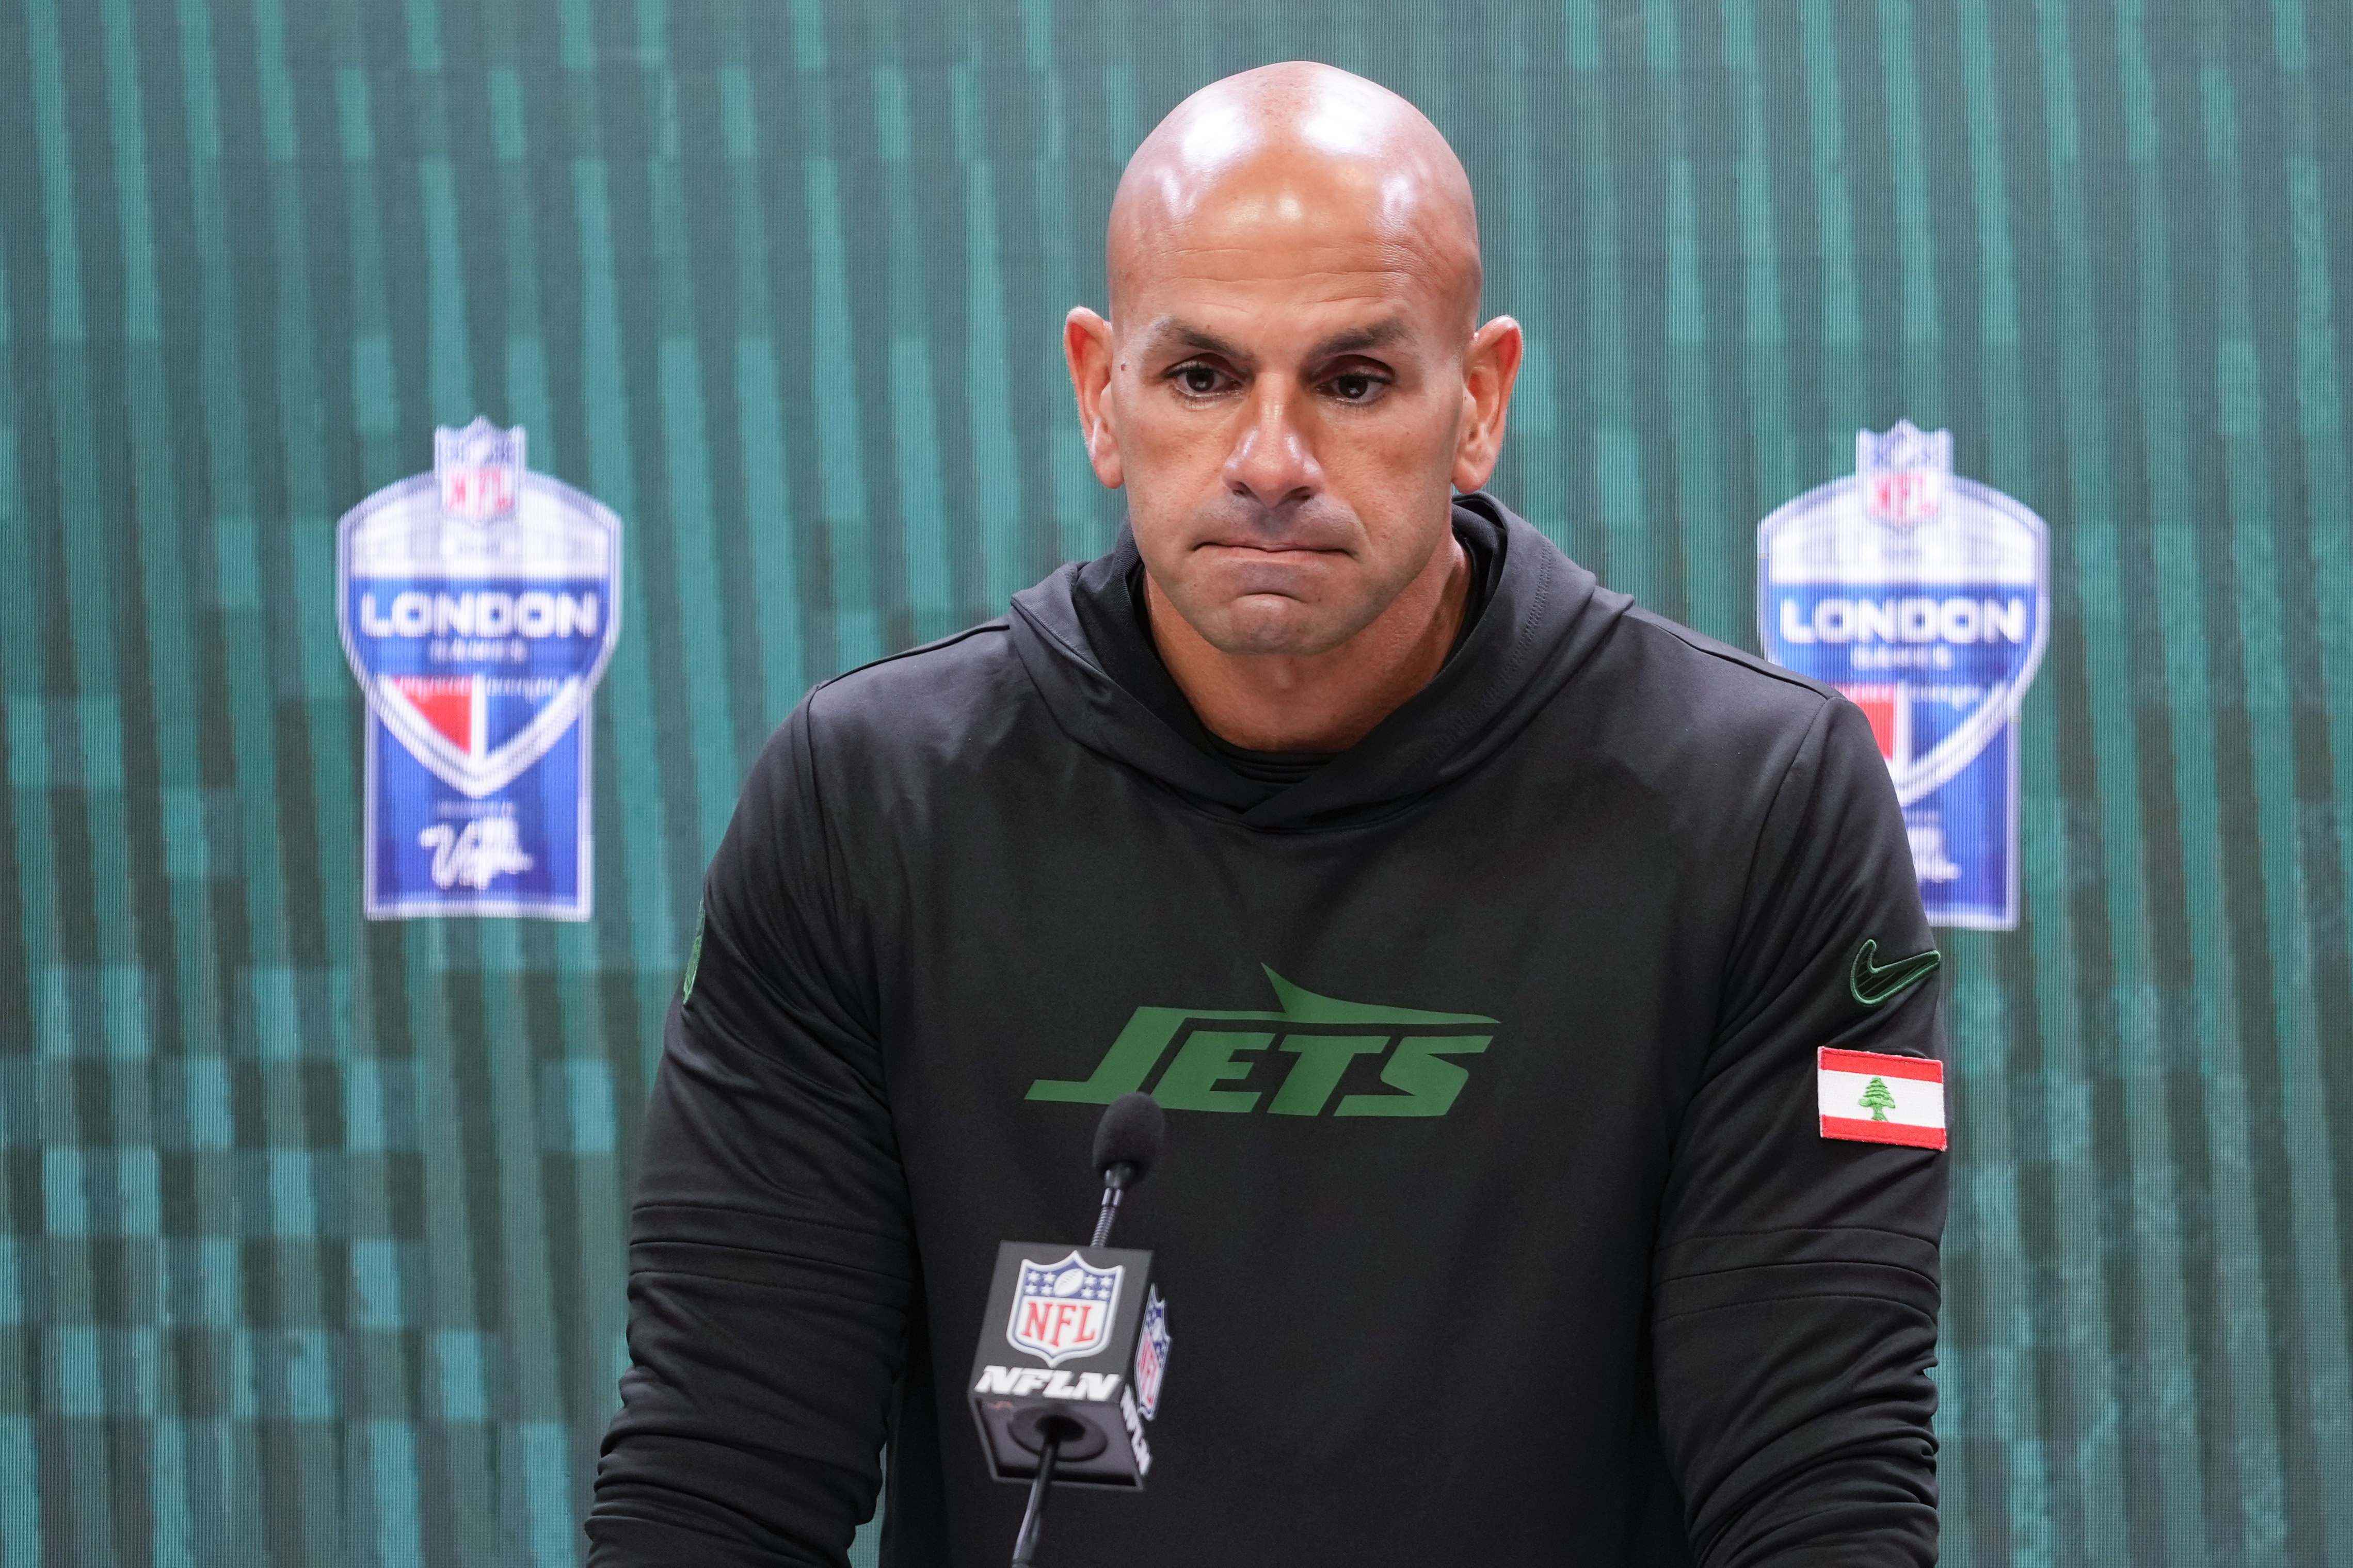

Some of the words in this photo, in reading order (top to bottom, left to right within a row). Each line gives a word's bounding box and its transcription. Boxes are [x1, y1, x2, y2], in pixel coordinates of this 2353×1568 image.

[361, 591, 597, 638] LONDON
[1780, 597, 2027, 644] LONDON
[1024, 1006, 1494, 1117] JETS
[1021, 1301, 1097, 1347] NFL
[974, 1365, 1122, 1401] NFLN
